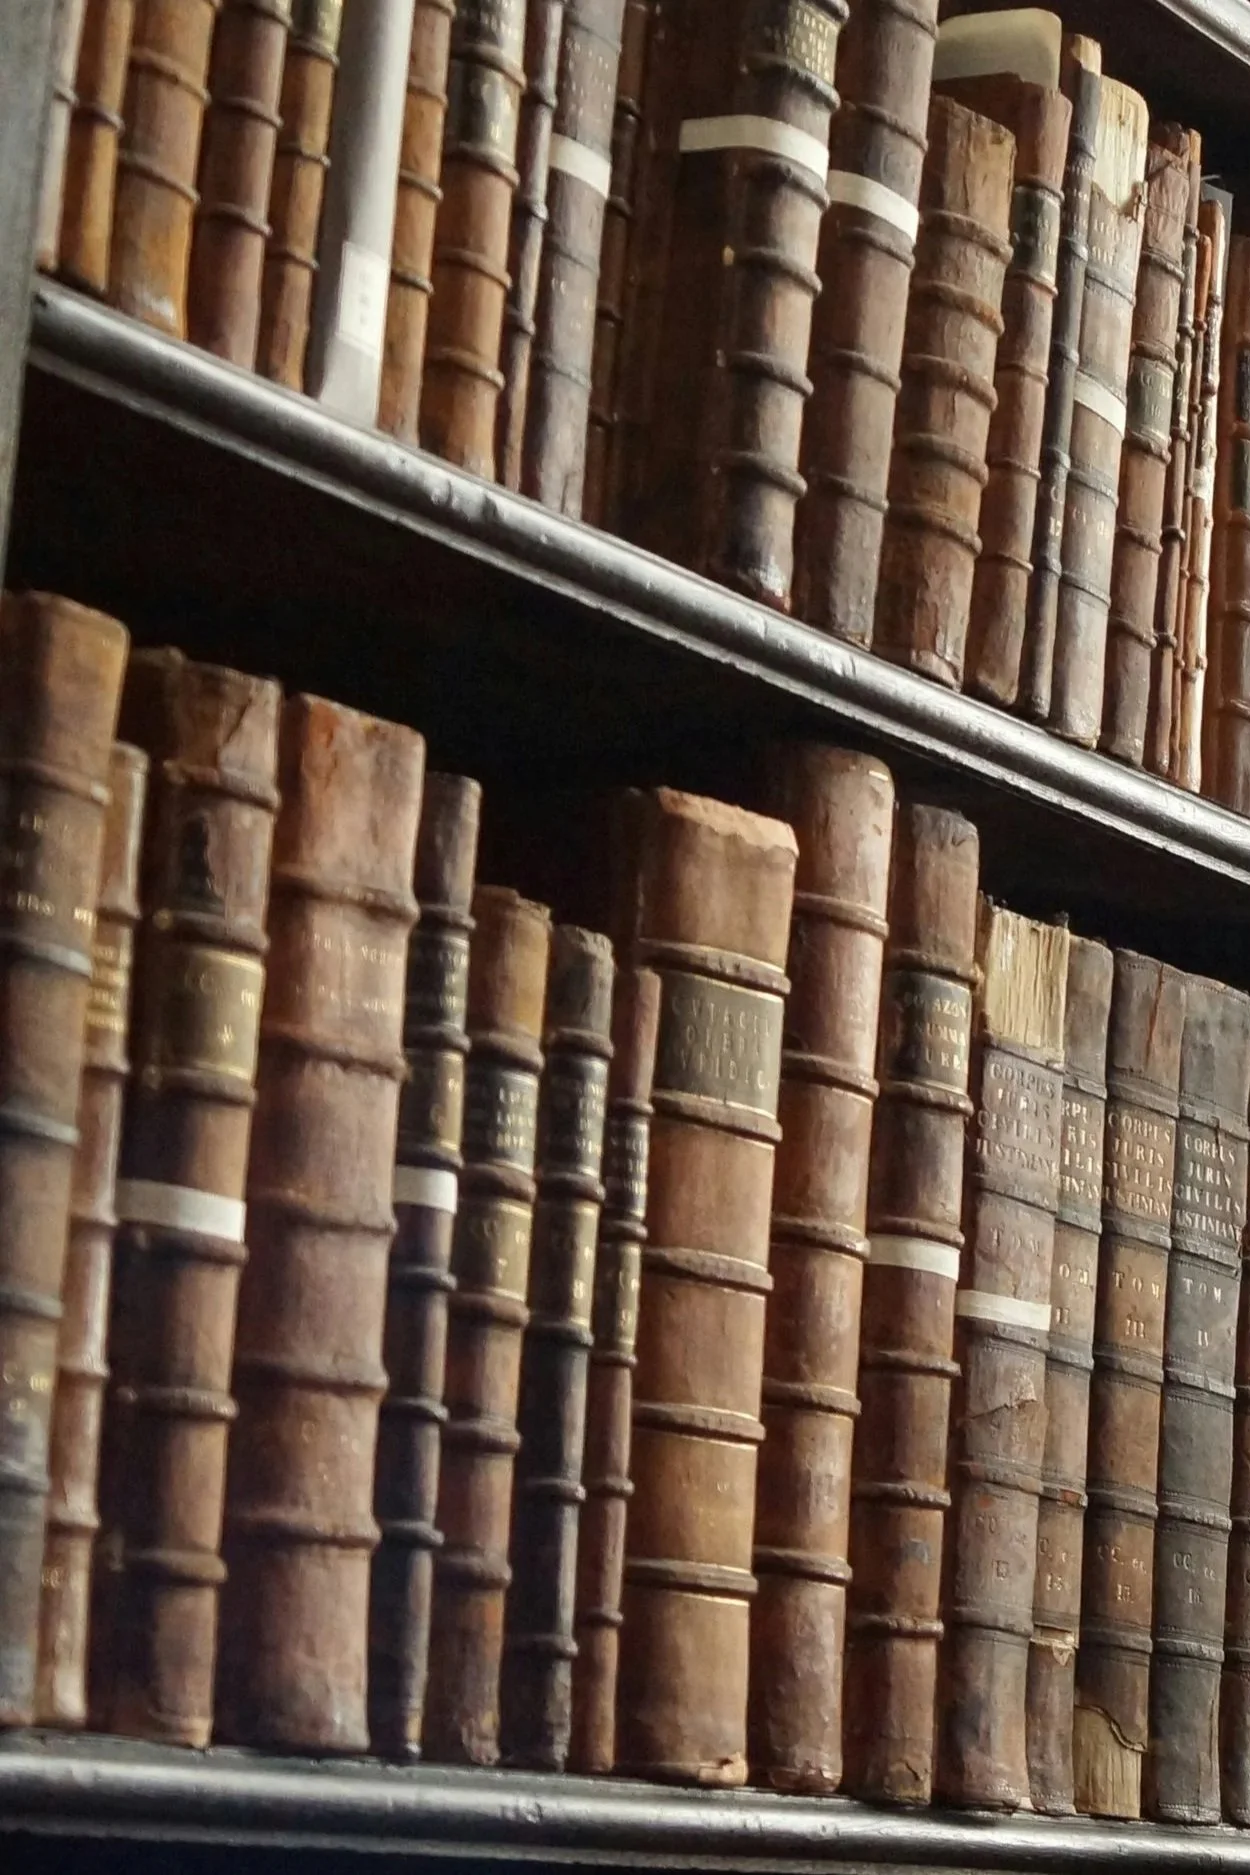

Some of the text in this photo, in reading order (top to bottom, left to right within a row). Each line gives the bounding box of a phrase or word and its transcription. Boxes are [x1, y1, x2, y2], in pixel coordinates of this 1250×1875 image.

[989, 1063, 1055, 1100] CORPUS
[1108, 1112, 1171, 1144] CORPUS
[1112, 1138, 1164, 1168] JURIS
[1184, 1133, 1236, 1166] CORPUS
[1187, 1161, 1232, 1190] JURIS
[1174, 1182, 1241, 1216] CIVILIS
